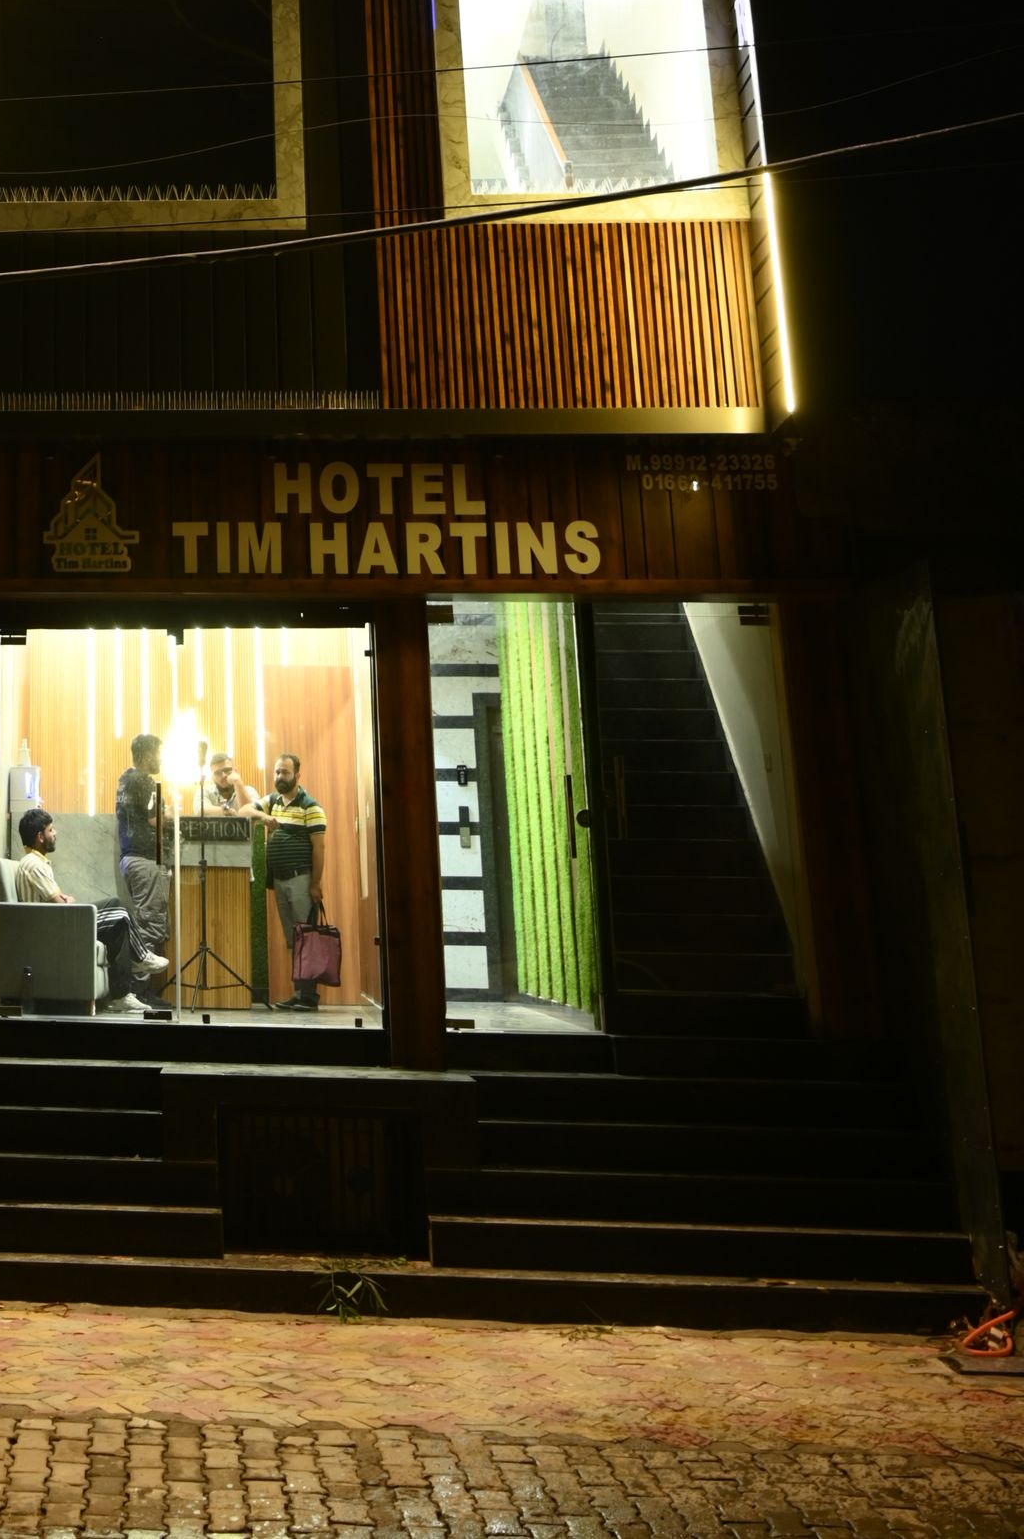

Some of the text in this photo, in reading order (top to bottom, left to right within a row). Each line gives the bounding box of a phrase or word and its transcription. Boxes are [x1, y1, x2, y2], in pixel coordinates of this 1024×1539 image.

[274, 460, 487, 516] HOTEL
[58, 542, 124, 556] HOTEL
[172, 520, 602, 576] TIM HARTINS
